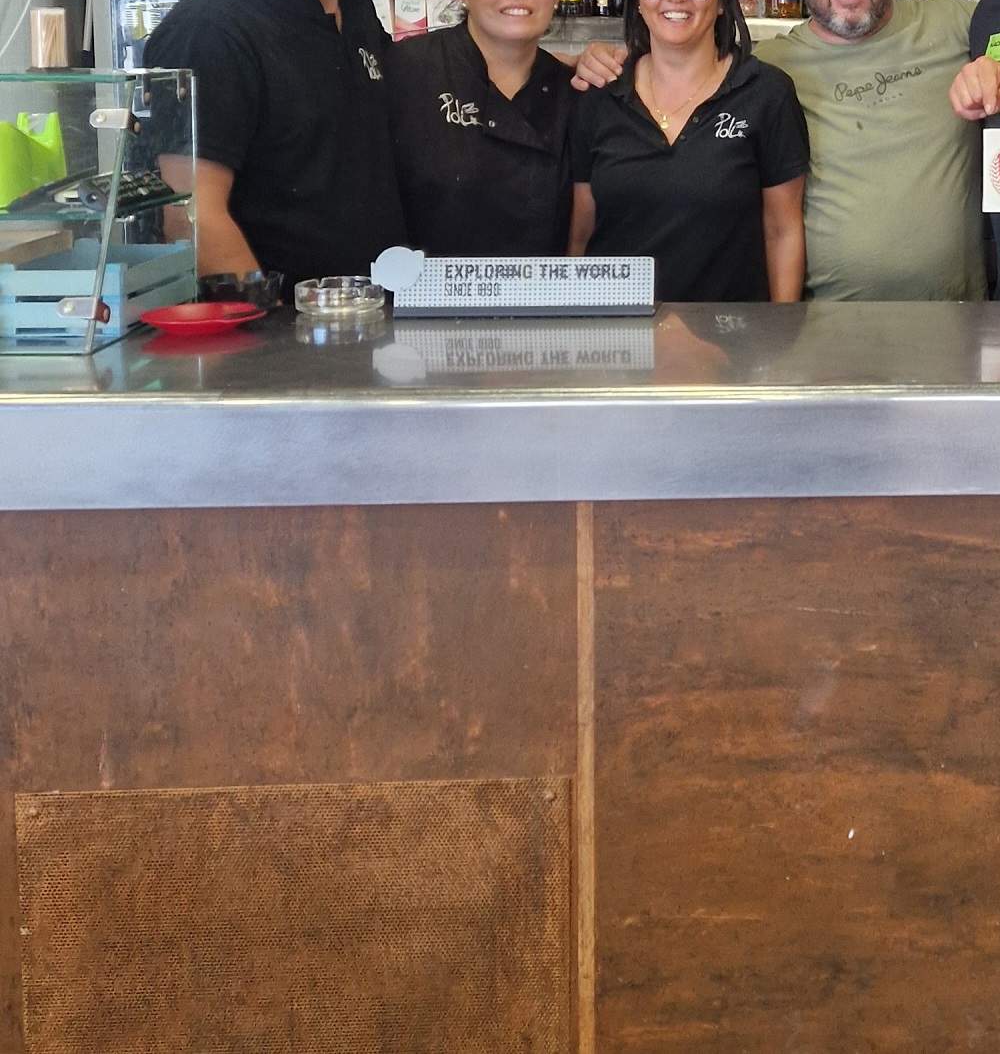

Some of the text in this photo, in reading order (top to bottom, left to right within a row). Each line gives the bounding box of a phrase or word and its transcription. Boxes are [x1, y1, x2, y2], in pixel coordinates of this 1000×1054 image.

[834, 81, 876, 102] Pepe
[874, 65, 923, 96] Jeans
[444, 263, 632, 281] EXPLORING THE WORLD
